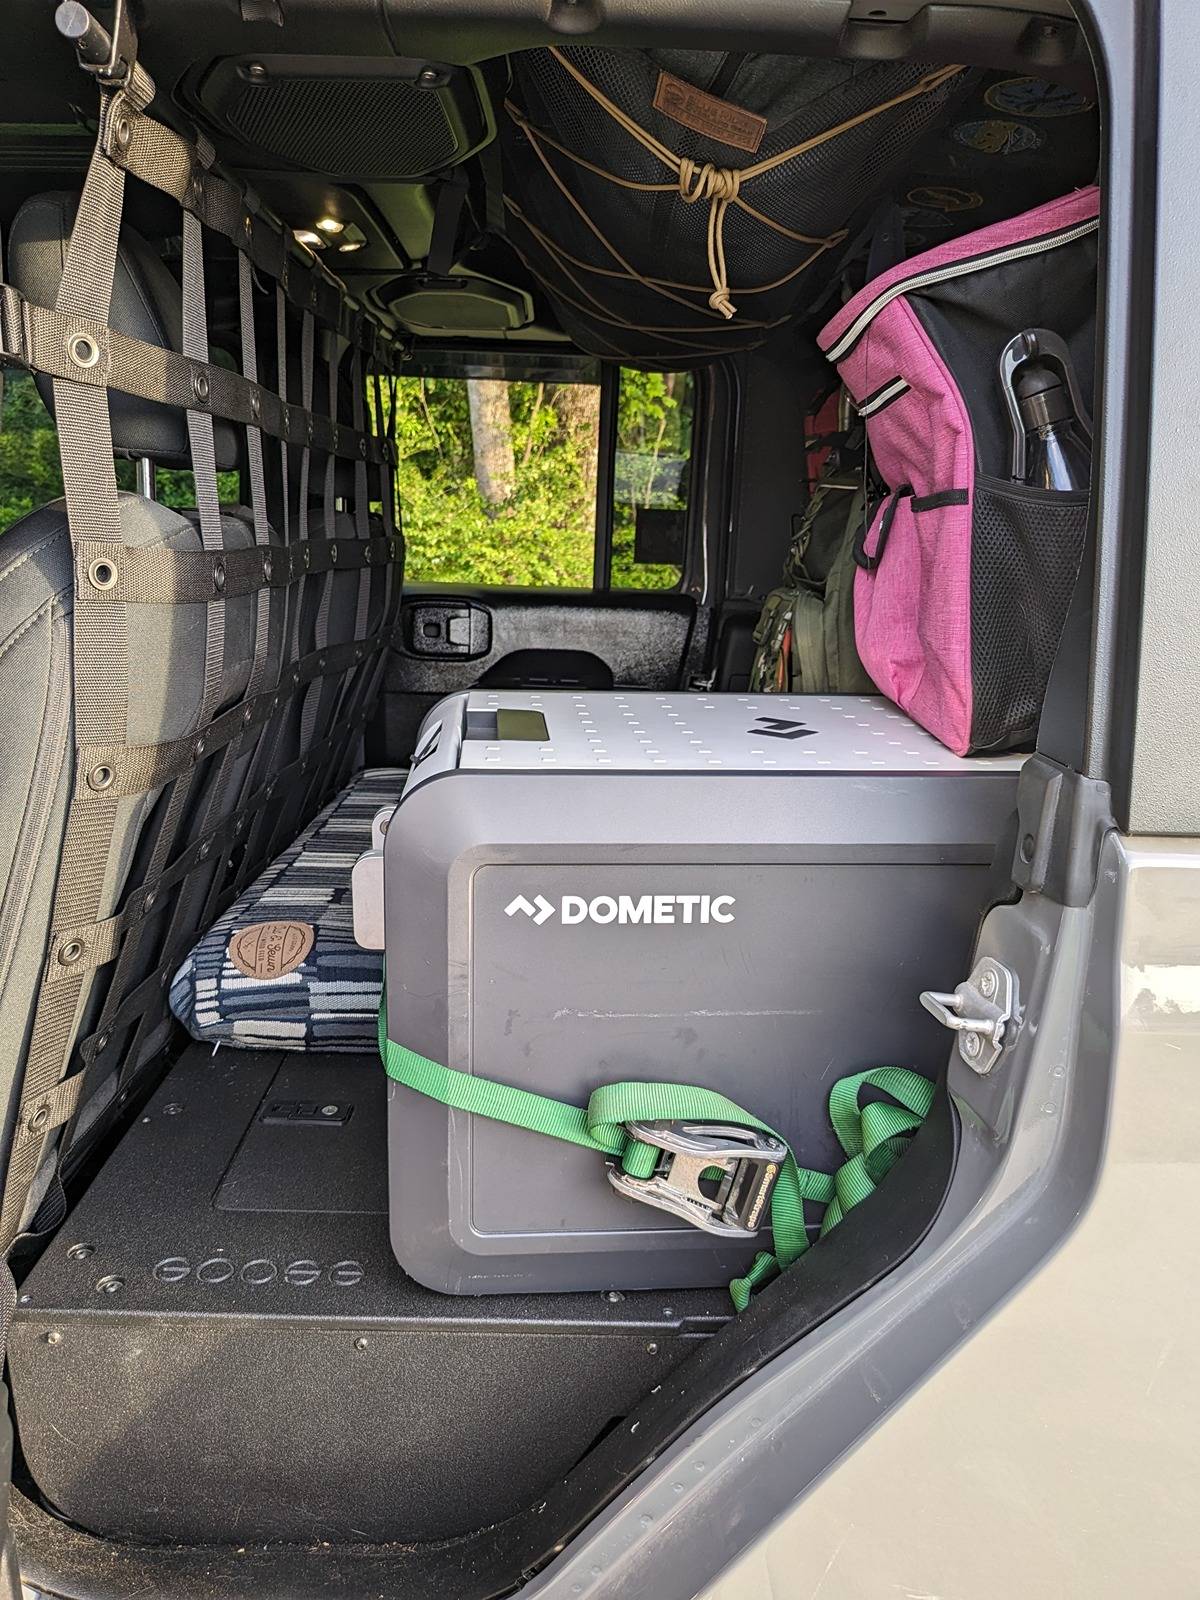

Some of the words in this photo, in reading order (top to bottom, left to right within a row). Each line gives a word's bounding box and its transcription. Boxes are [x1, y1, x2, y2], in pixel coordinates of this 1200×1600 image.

[561, 895, 736, 925] DOMETIC
[748, 1172, 774, 1228] SmartStraps
[152, 1257, 364, 1286] GOOSE
